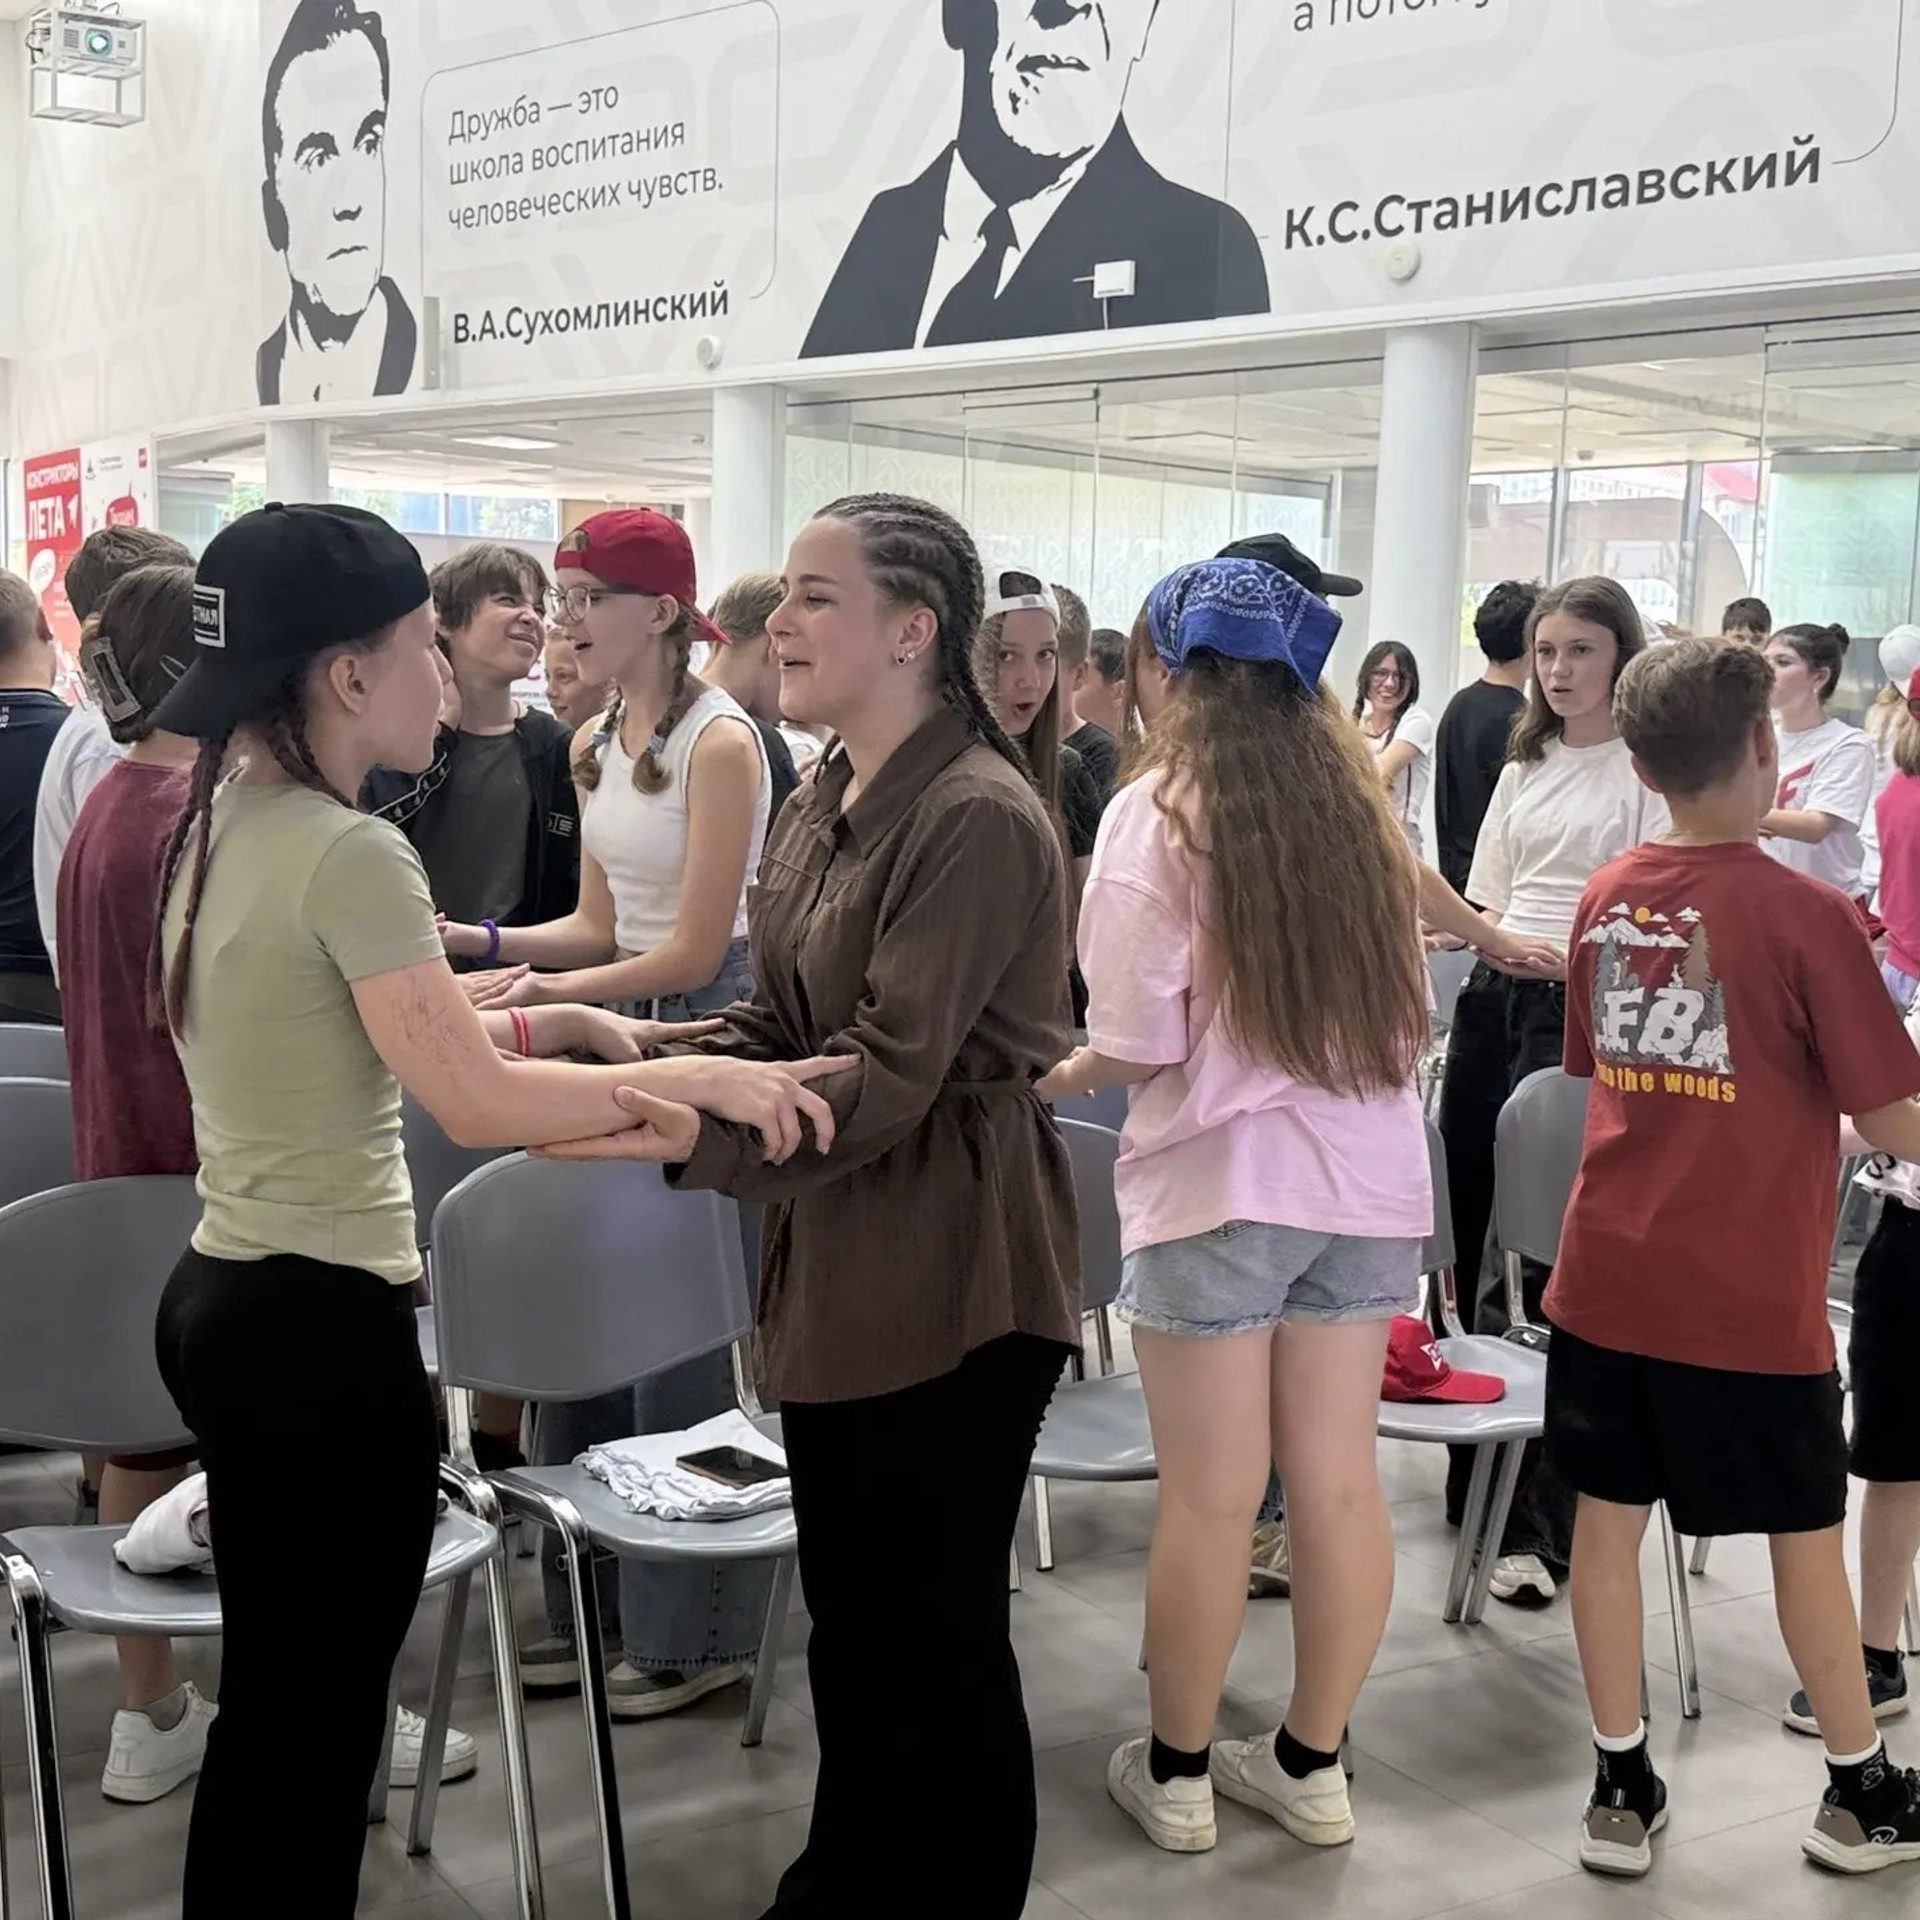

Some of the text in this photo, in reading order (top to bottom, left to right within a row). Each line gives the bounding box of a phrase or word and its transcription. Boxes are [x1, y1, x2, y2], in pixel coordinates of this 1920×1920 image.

[1294, 2, 1313, 31] а
[448, 94, 540, 146] Дружба
[578, 85, 619, 115] это
[449, 122, 685, 186] школа воспитания
[448, 167, 724, 230] человеческих чувств.
[1285, 133, 1821, 250] К.С.Станиславский
[454, 279, 729, 345] В.А.Сухомлинский
[28, 495, 66, 541] ЛЕТА
[1617, 1066, 1655, 1093] the
[1663, 1071, 1736, 1103] woods
